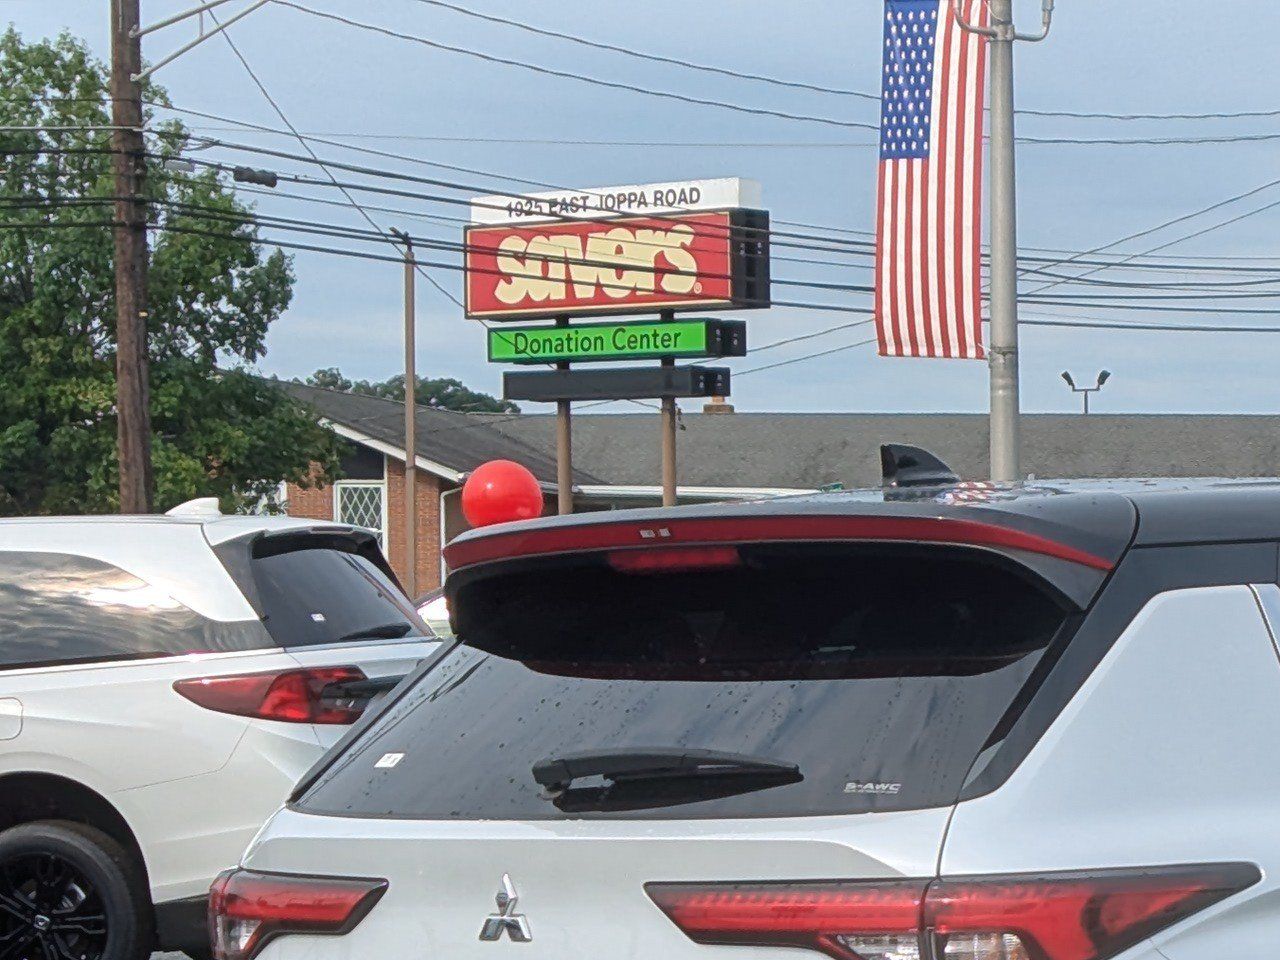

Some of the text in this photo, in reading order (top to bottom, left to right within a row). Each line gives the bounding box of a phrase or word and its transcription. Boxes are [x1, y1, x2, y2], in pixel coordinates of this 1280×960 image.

[507, 187, 701, 217] 1925 EAST JOPPA ROAD
[514, 327, 681, 355] Donation Center
